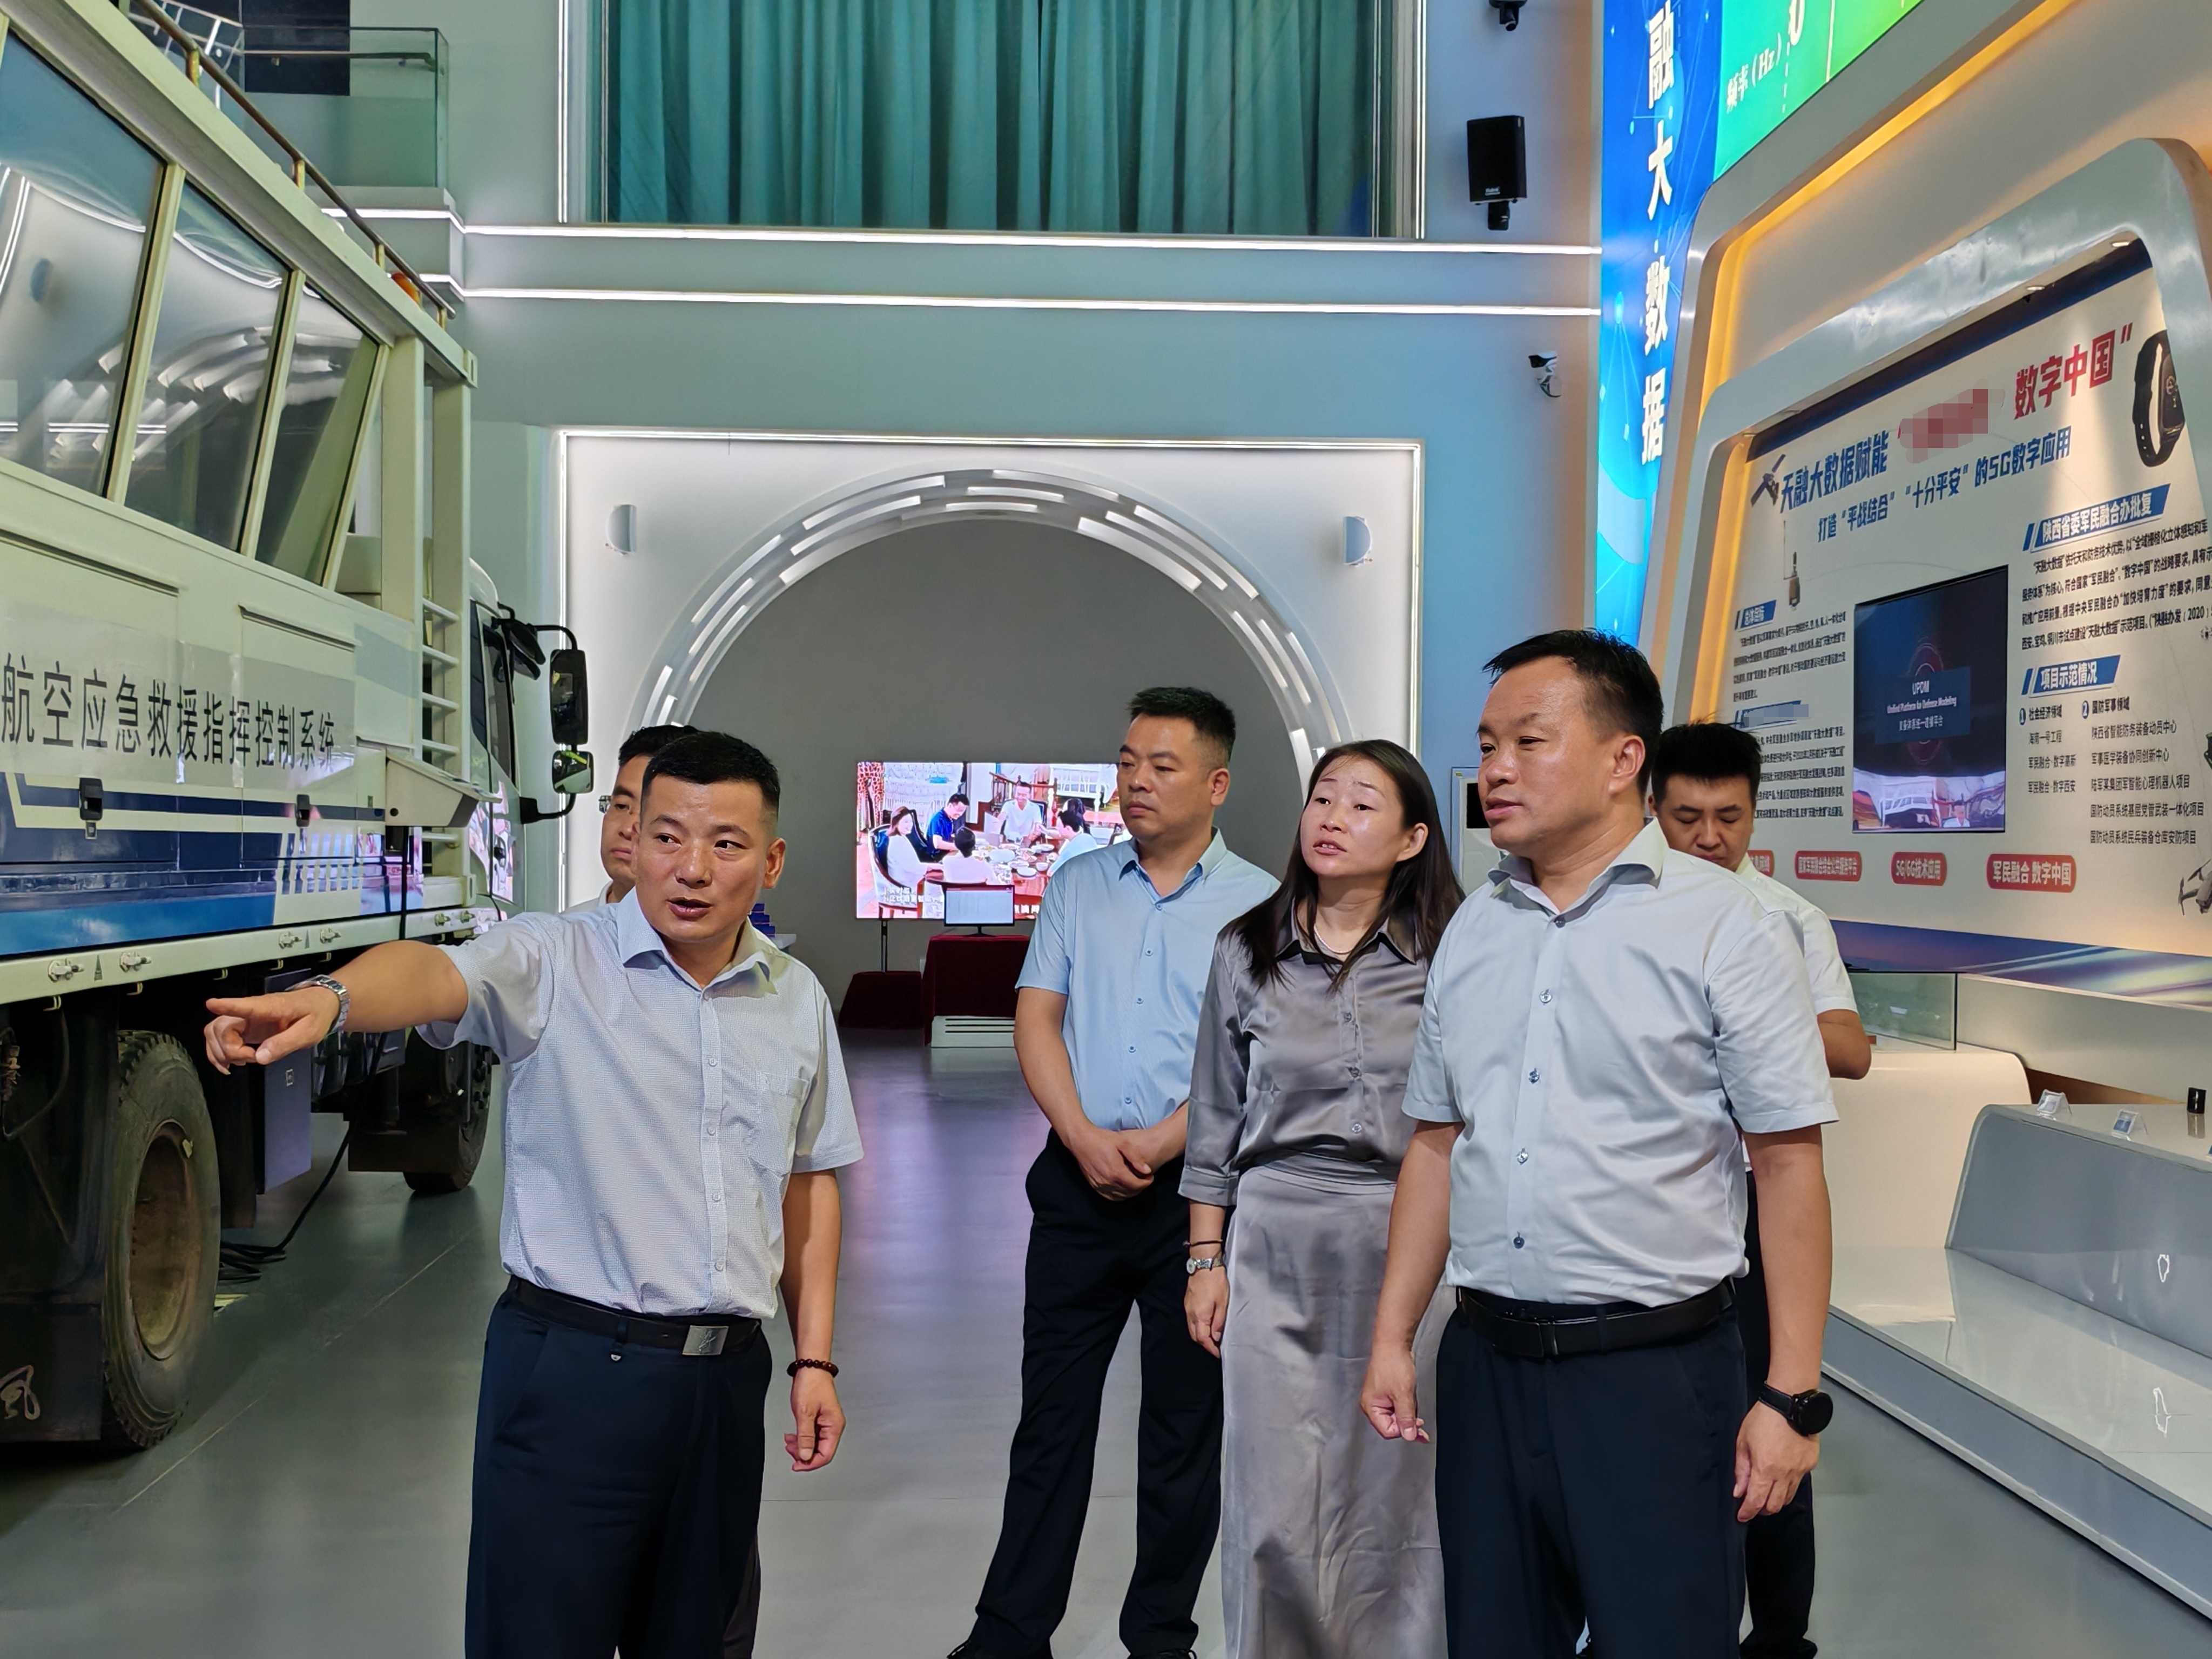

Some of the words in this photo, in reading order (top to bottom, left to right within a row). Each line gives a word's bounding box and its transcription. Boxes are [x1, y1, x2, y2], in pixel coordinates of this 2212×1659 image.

[1779, 430, 1890, 514] 天融大数据赋能
[2042, 493, 2152, 543] 陕西省委军民融合办批复
[2041, 662, 2098, 690] 项目示范情况
[2, 653, 335, 771] 航空应急救援指挥控制系统
[2092, 697, 2130, 714] 国防军事领域
[2091, 719, 2177, 740] 陕西省智能防务装备动员中心
[2091, 748, 2169, 766] 军事医学装备协同创新中心
[2090, 774, 2190, 792] 陆军某集团军智能心理机器人项目
[2090, 801, 2204, 818] 国防动员系统基层党管武装一体化项目
[2090, 830, 2196, 845] 国防动员系统民兵装备仓库安防项目
[1992, 860, 2029, 884] 军民融合
[2032, 861, 2072, 887] 数字中国
